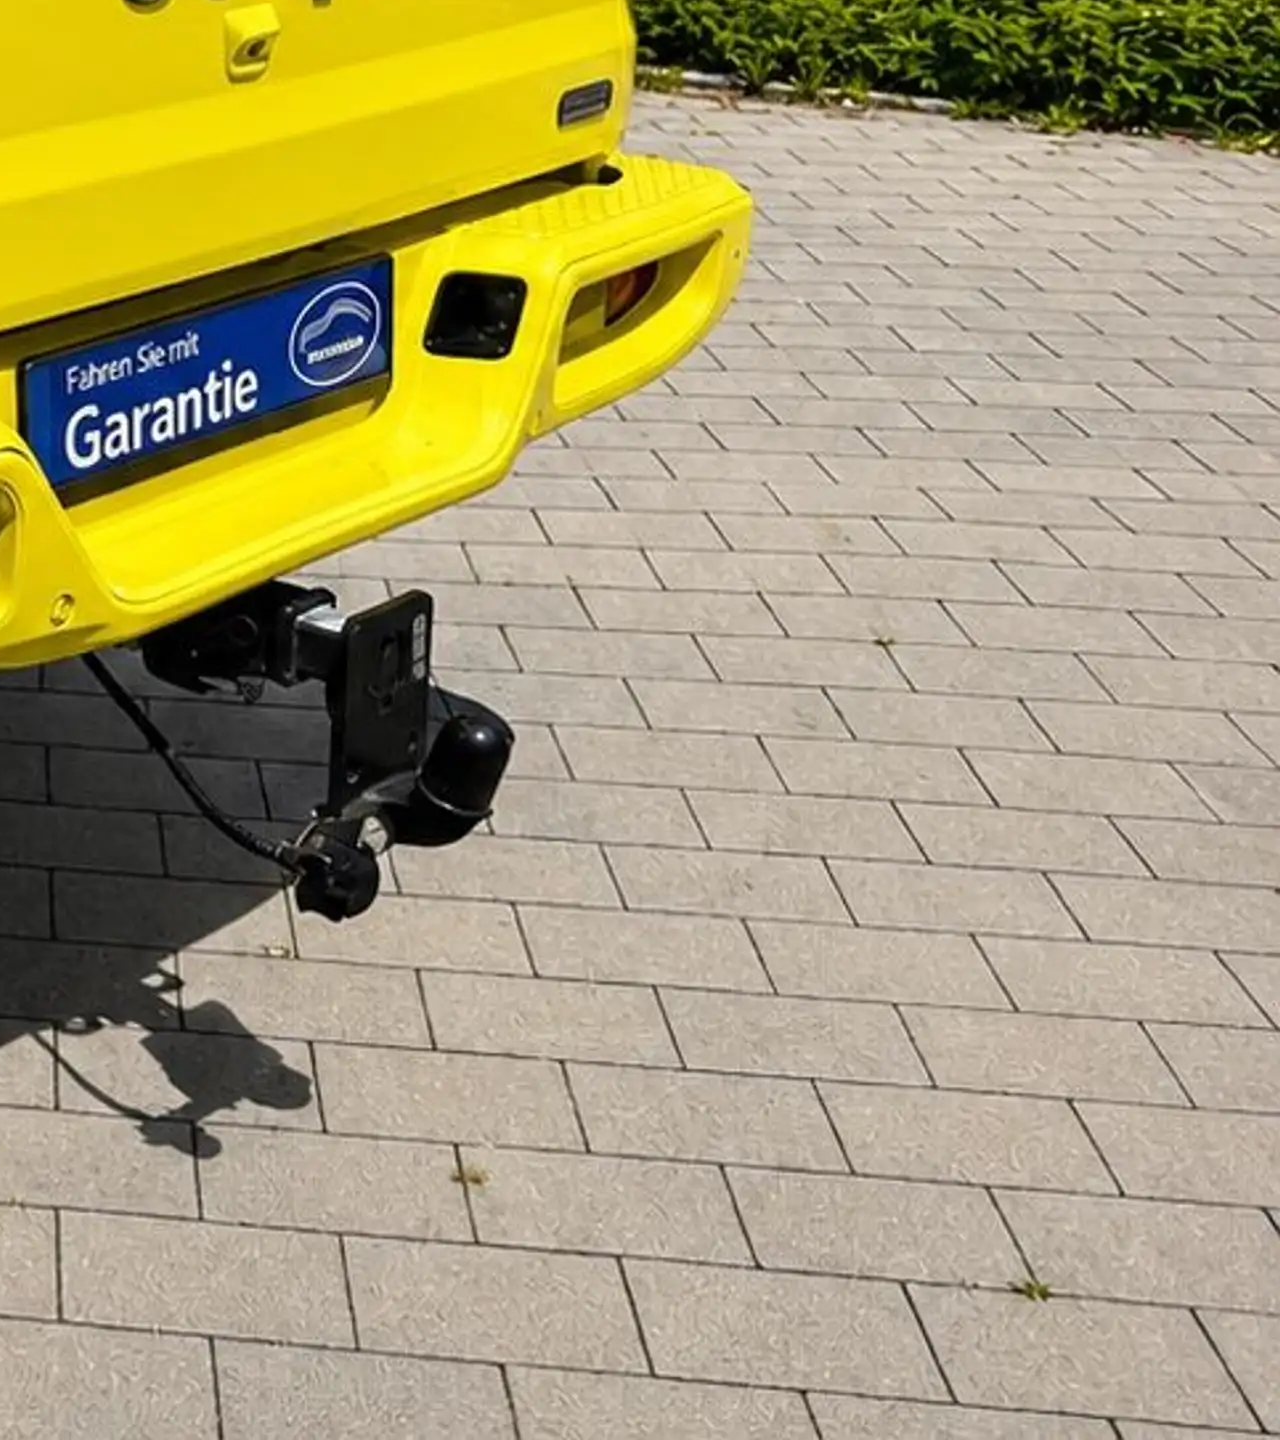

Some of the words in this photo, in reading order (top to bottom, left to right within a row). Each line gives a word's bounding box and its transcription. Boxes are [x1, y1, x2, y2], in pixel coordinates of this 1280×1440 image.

[65, 356, 133, 395] Fahren
[137, 340, 165, 373] Sie
[168, 330, 200, 363] mit
[65, 359, 259, 469] Garantie
